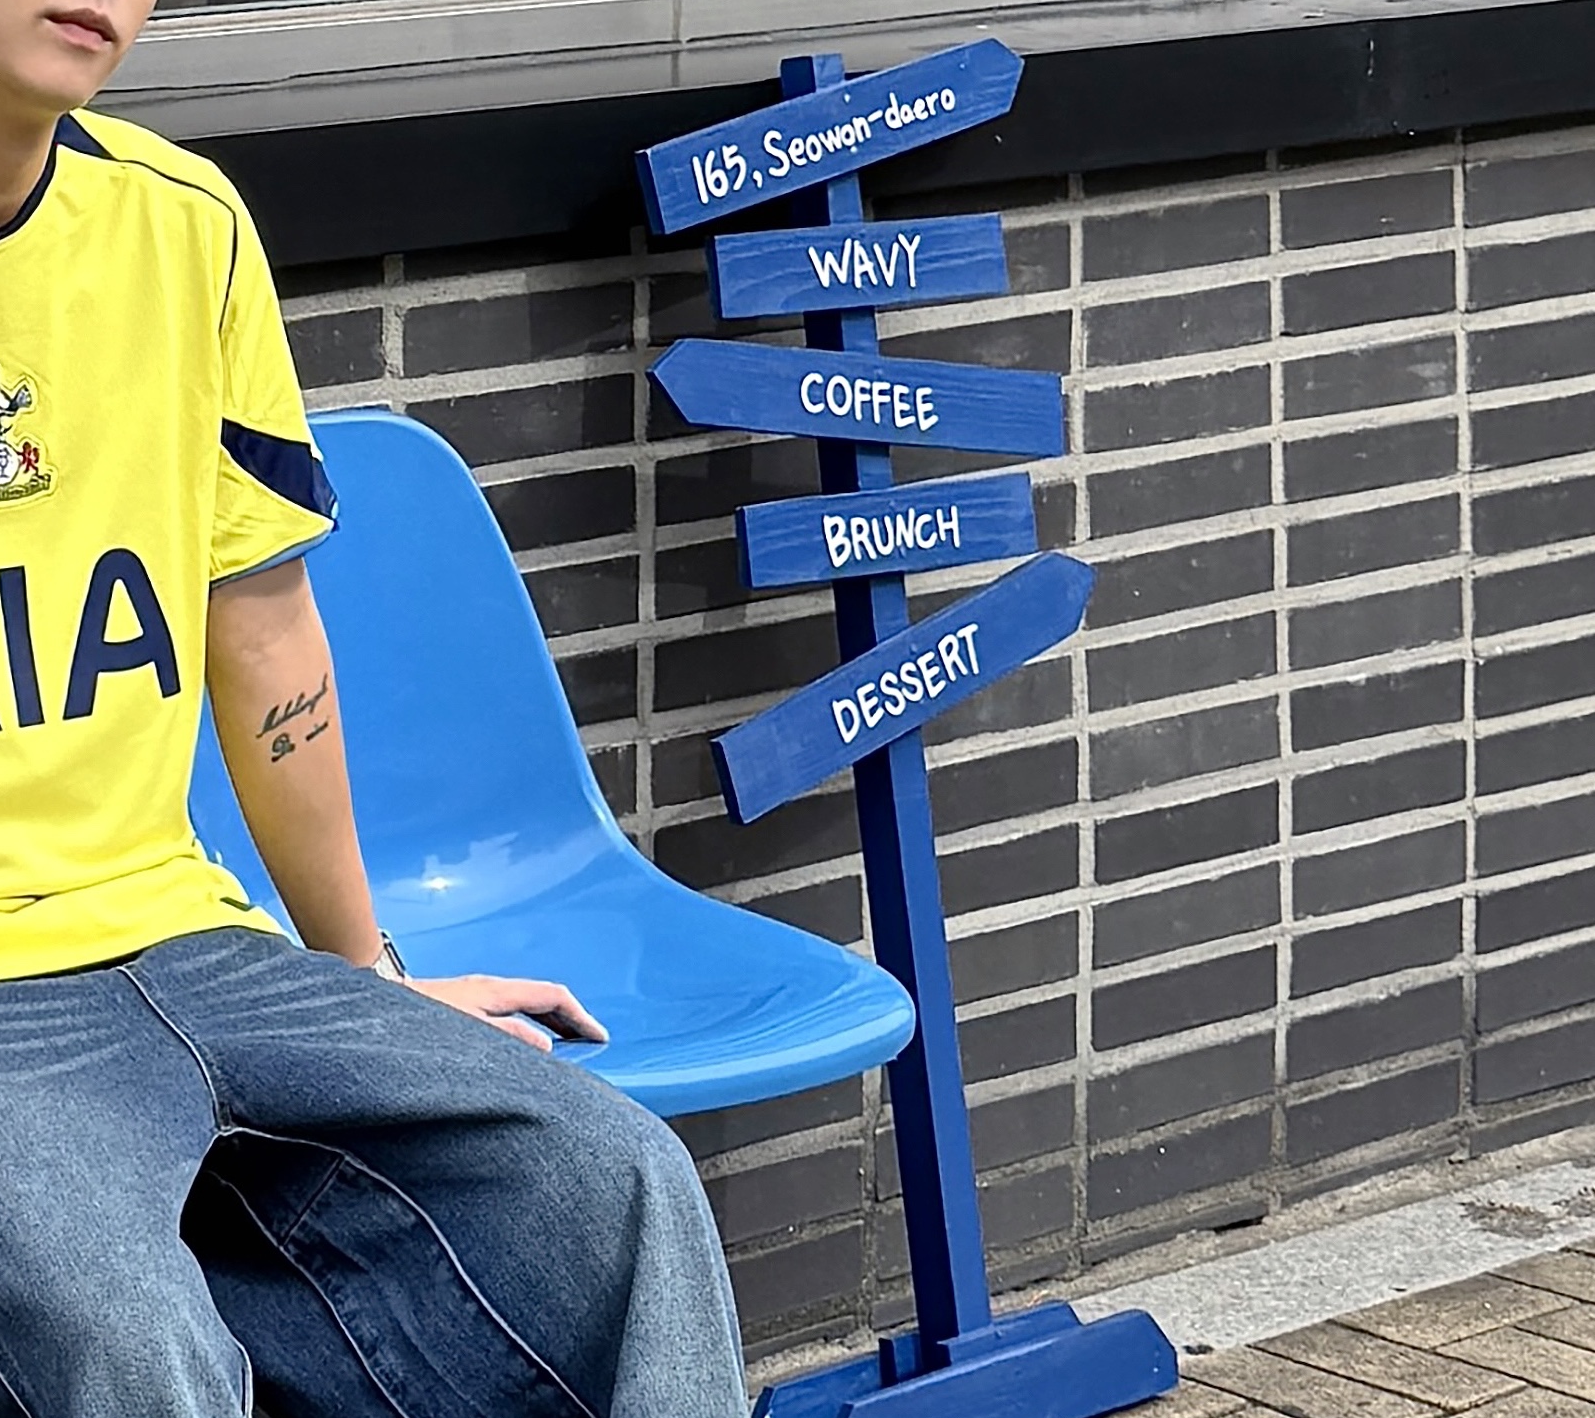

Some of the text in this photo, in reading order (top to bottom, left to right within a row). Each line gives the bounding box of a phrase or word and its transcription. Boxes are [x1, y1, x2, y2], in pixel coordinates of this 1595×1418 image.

[808, 233, 921, 289] WAVY
[800, 372, 940, 432] COFFEE
[823, 504, 961, 568] BRUNCH
[832, 622, 982, 744] DESSERT
